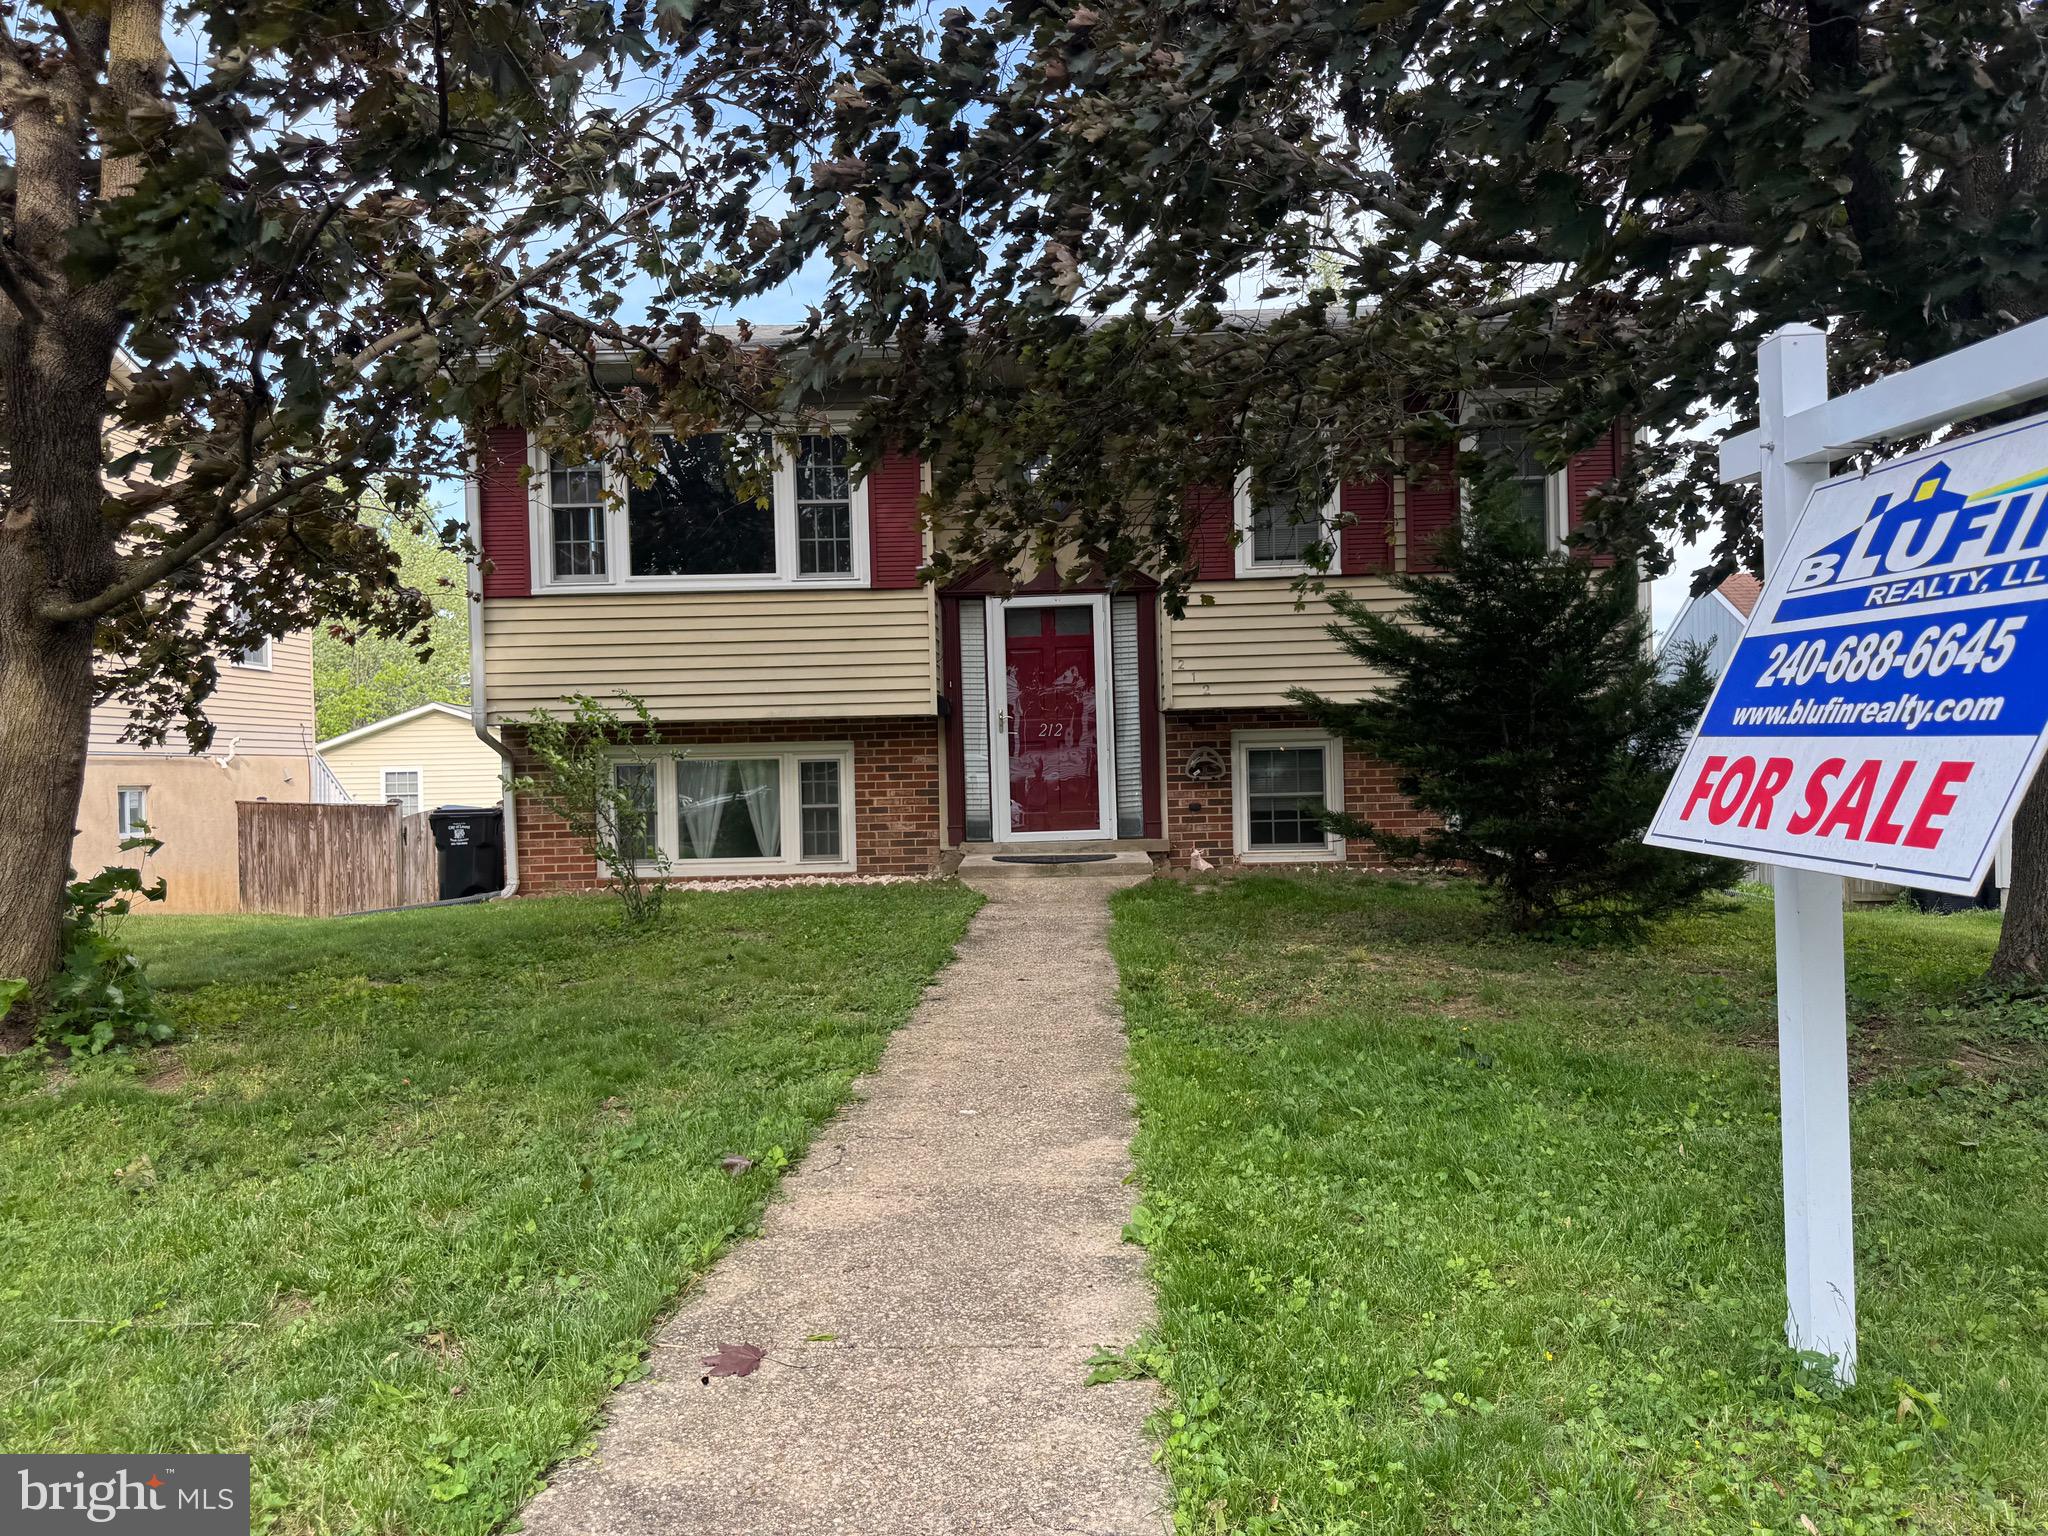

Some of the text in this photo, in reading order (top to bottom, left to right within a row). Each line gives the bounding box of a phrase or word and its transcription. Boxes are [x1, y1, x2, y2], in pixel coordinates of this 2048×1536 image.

[1863, 567, 1990, 607] REALTY,
[1754, 615, 2028, 688] 240-688-6645
[1038, 722, 1063, 737] 212
[1732, 693, 2005, 730] www.blufinrealty.com
[1680, 755, 1975, 850] FOR SALE
